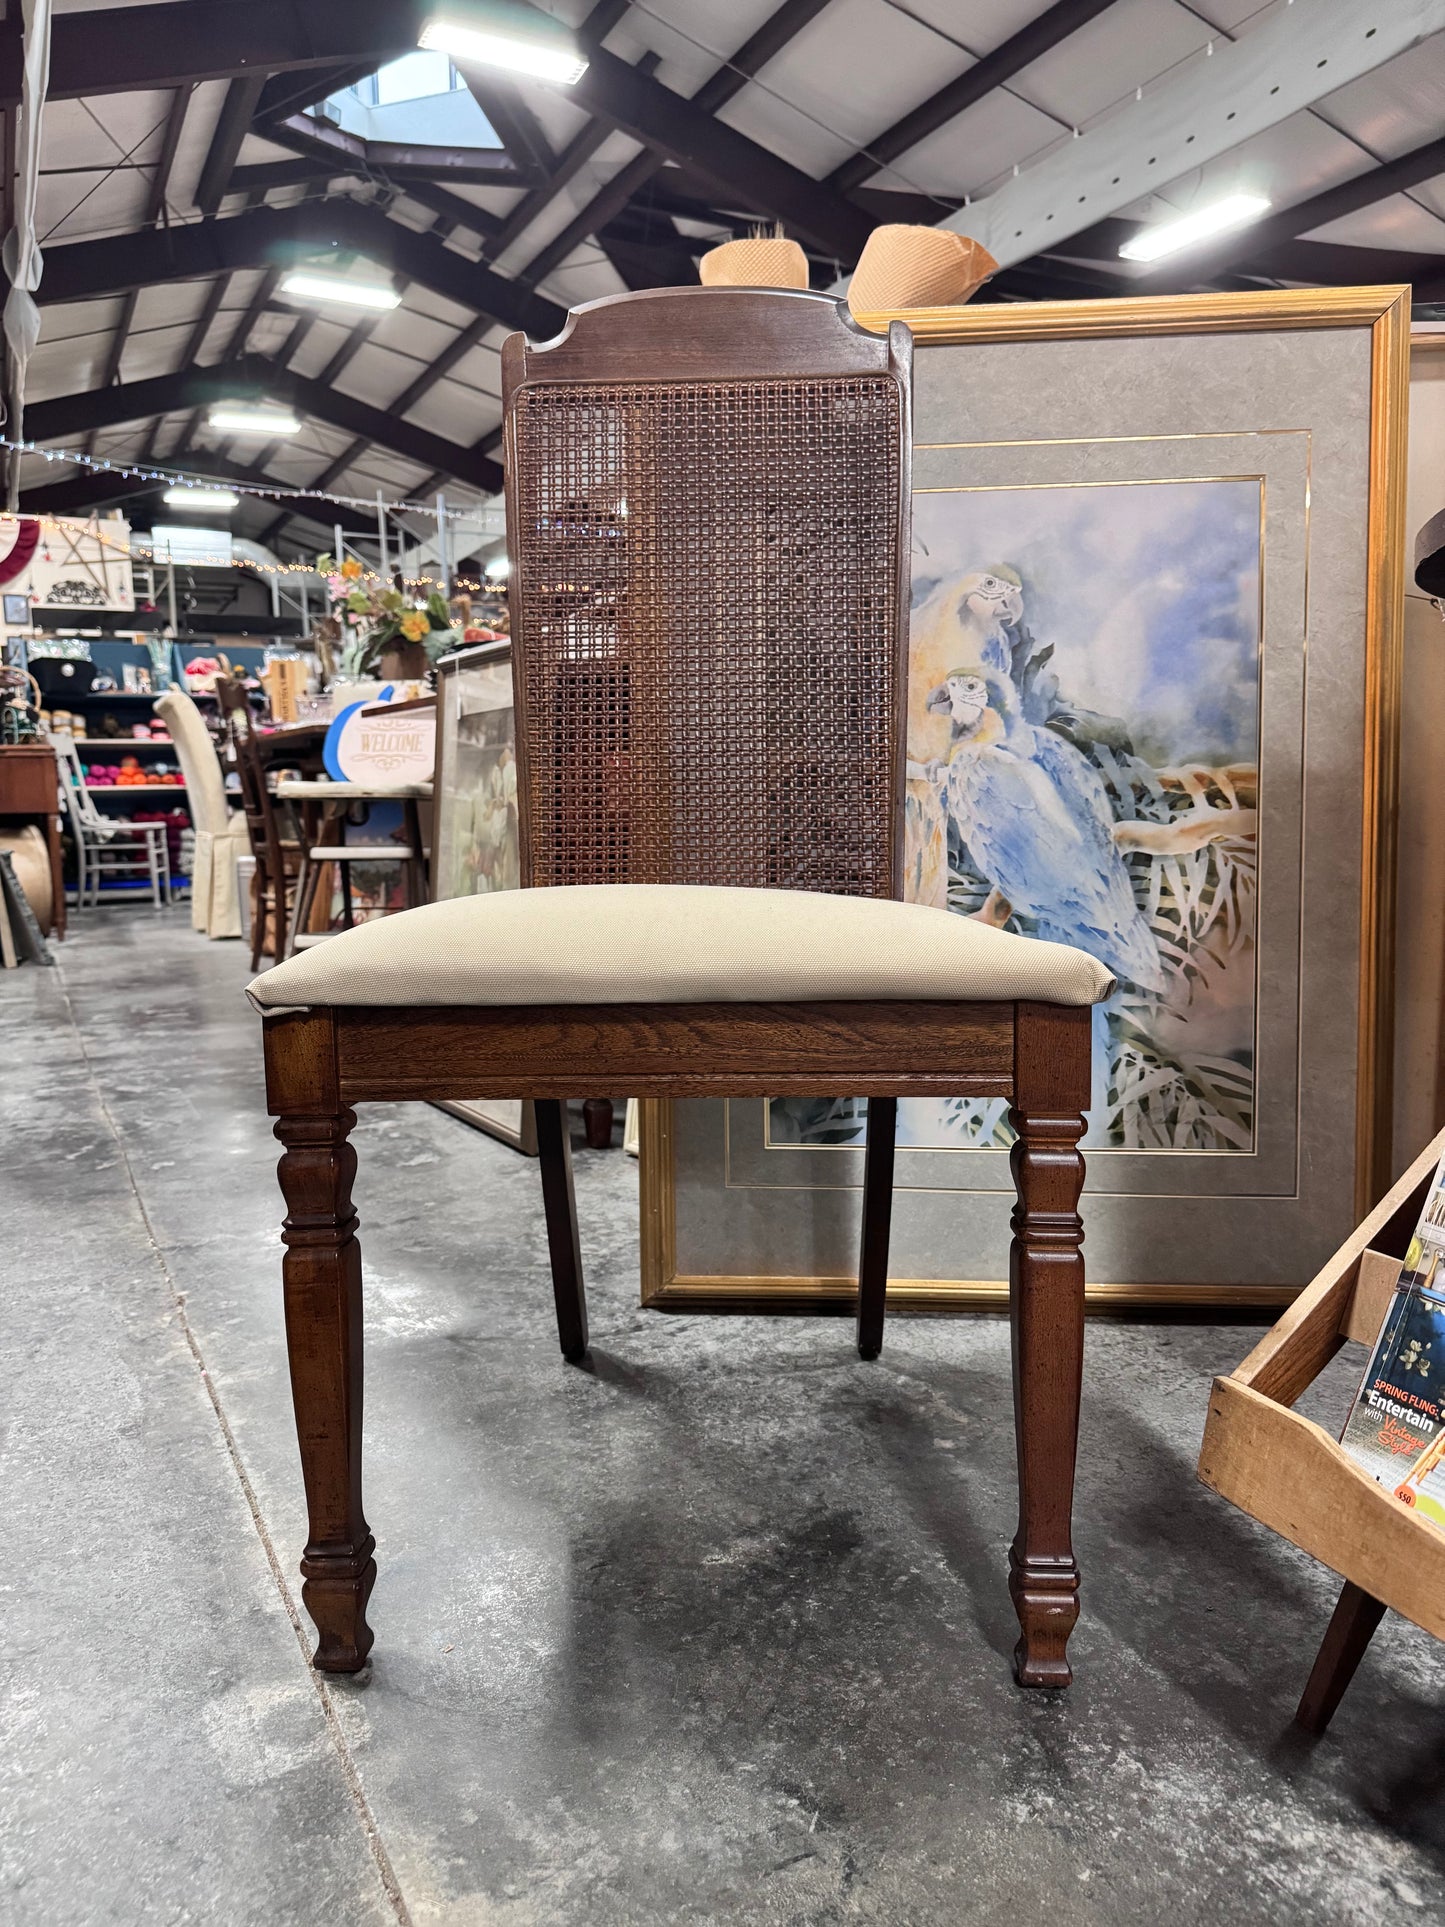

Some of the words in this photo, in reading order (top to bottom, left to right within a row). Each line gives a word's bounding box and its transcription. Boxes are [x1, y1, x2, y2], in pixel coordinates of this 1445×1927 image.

[361, 733, 424, 753] WELCOME
[1368, 1389, 1434, 1433] Entertain
[1374, 1379, 1409, 1402] SPRING
[1409, 1395, 1440, 1416] FLING:
[1364, 1407, 1383, 1422] with
[1384, 1414, 1426, 1450] Vintage
[1377, 1431, 1412, 1456] Style
